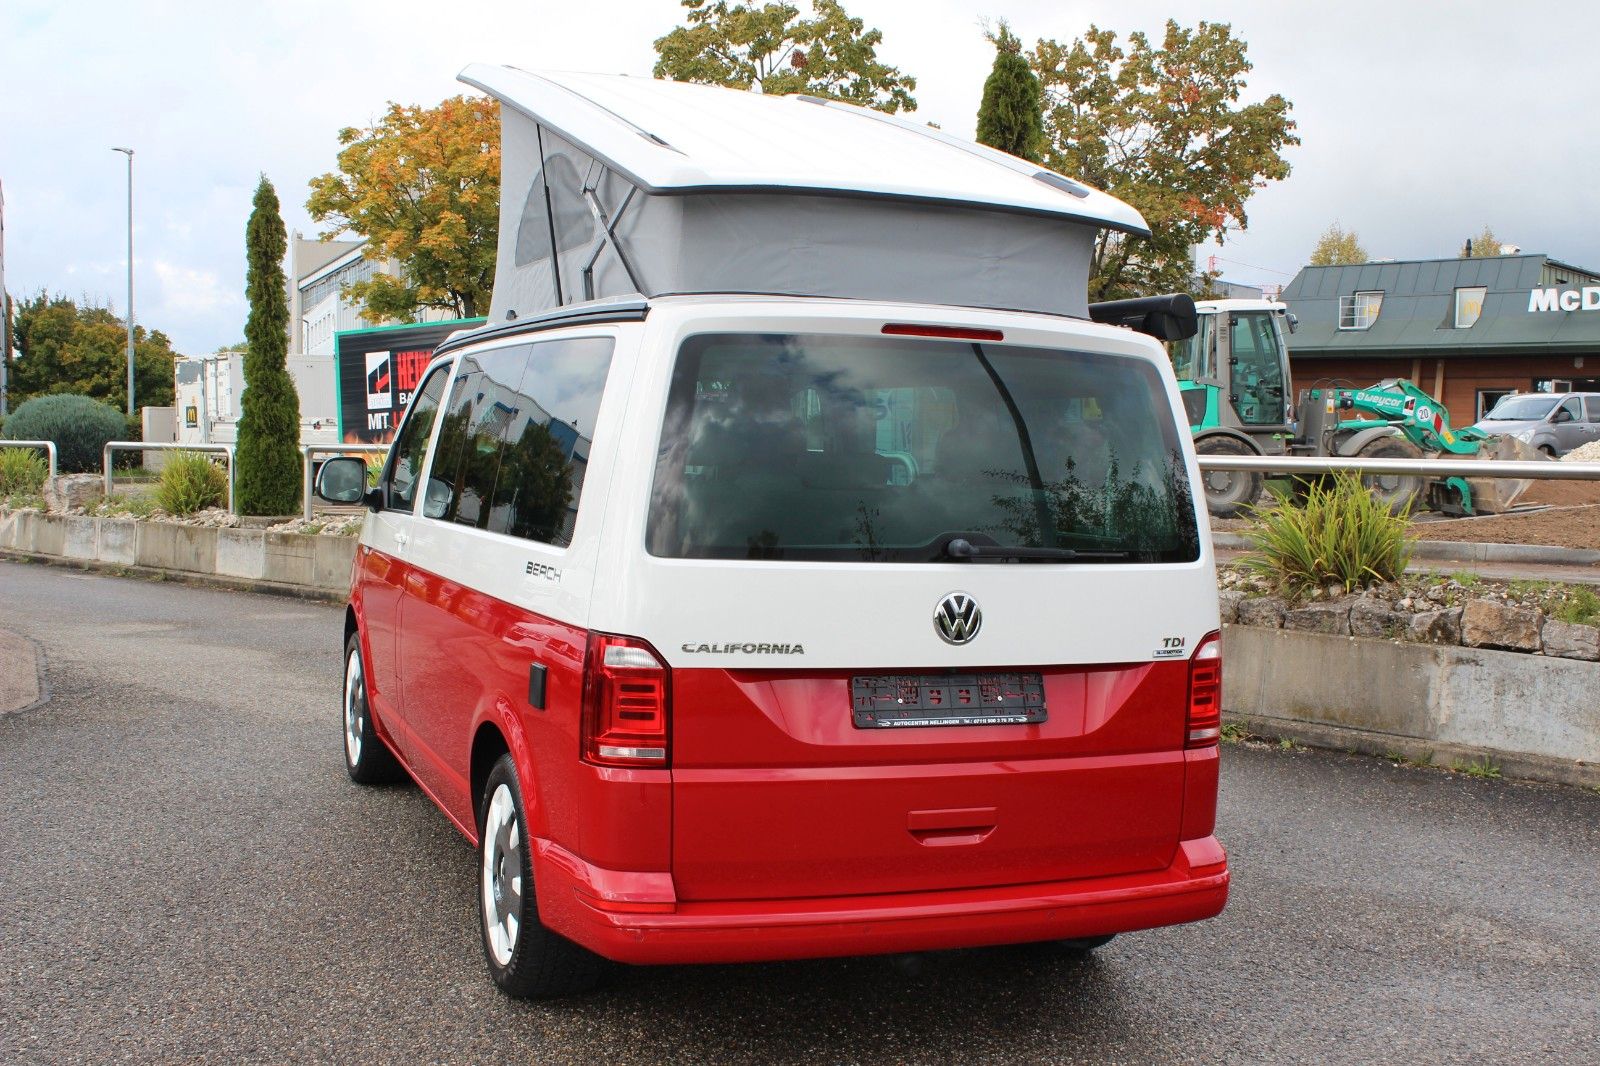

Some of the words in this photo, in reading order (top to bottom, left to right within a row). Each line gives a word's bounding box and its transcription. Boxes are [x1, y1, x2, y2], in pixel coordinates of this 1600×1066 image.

[1419, 408, 1429, 420] 20
[367, 412, 390, 430] MIT
[526, 560, 562, 583] BEACH
[1162, 637, 1186, 648] TDI
[681, 643, 805, 655] CALIFORNIA
